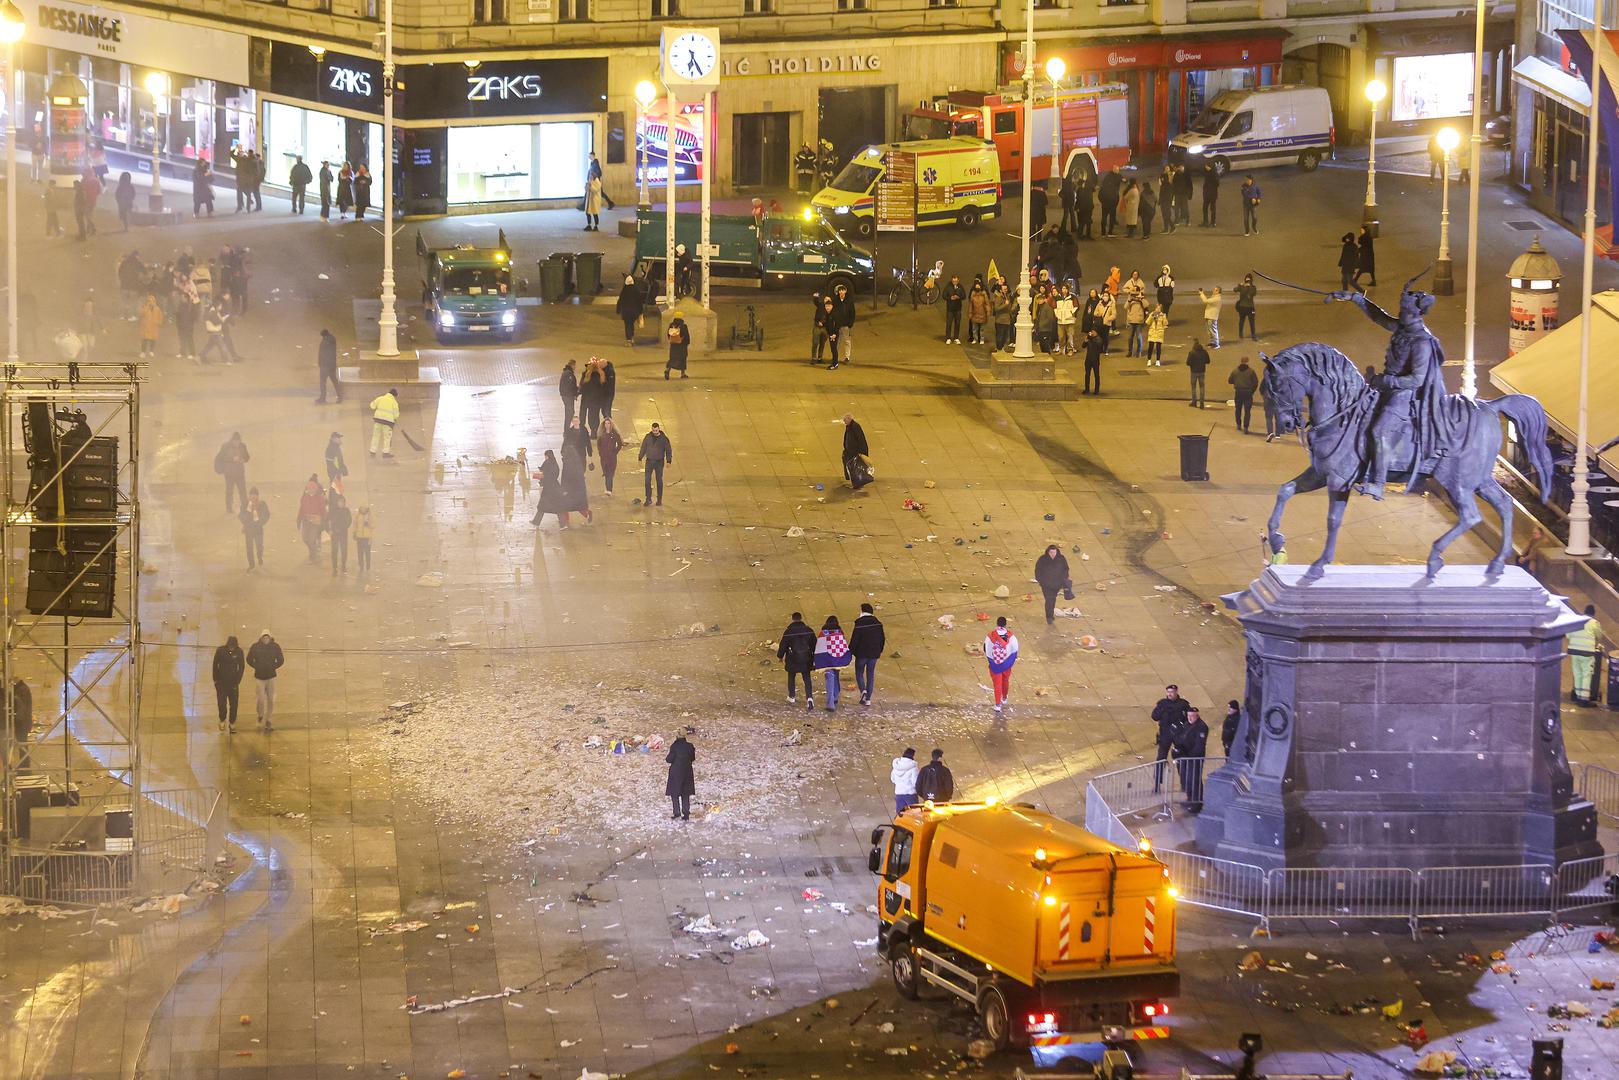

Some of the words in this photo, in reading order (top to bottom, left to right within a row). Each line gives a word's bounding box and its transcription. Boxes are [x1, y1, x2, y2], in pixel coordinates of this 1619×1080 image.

[38, 5, 121, 42] DESSANGE
[97, 43, 117, 53] PARIS
[769, 54, 881, 75] HOLDING
[328, 65, 372, 97] ZAKS
[466, 75, 542, 101] ZAKS
[1257, 138, 1294, 148] POLICIJA
